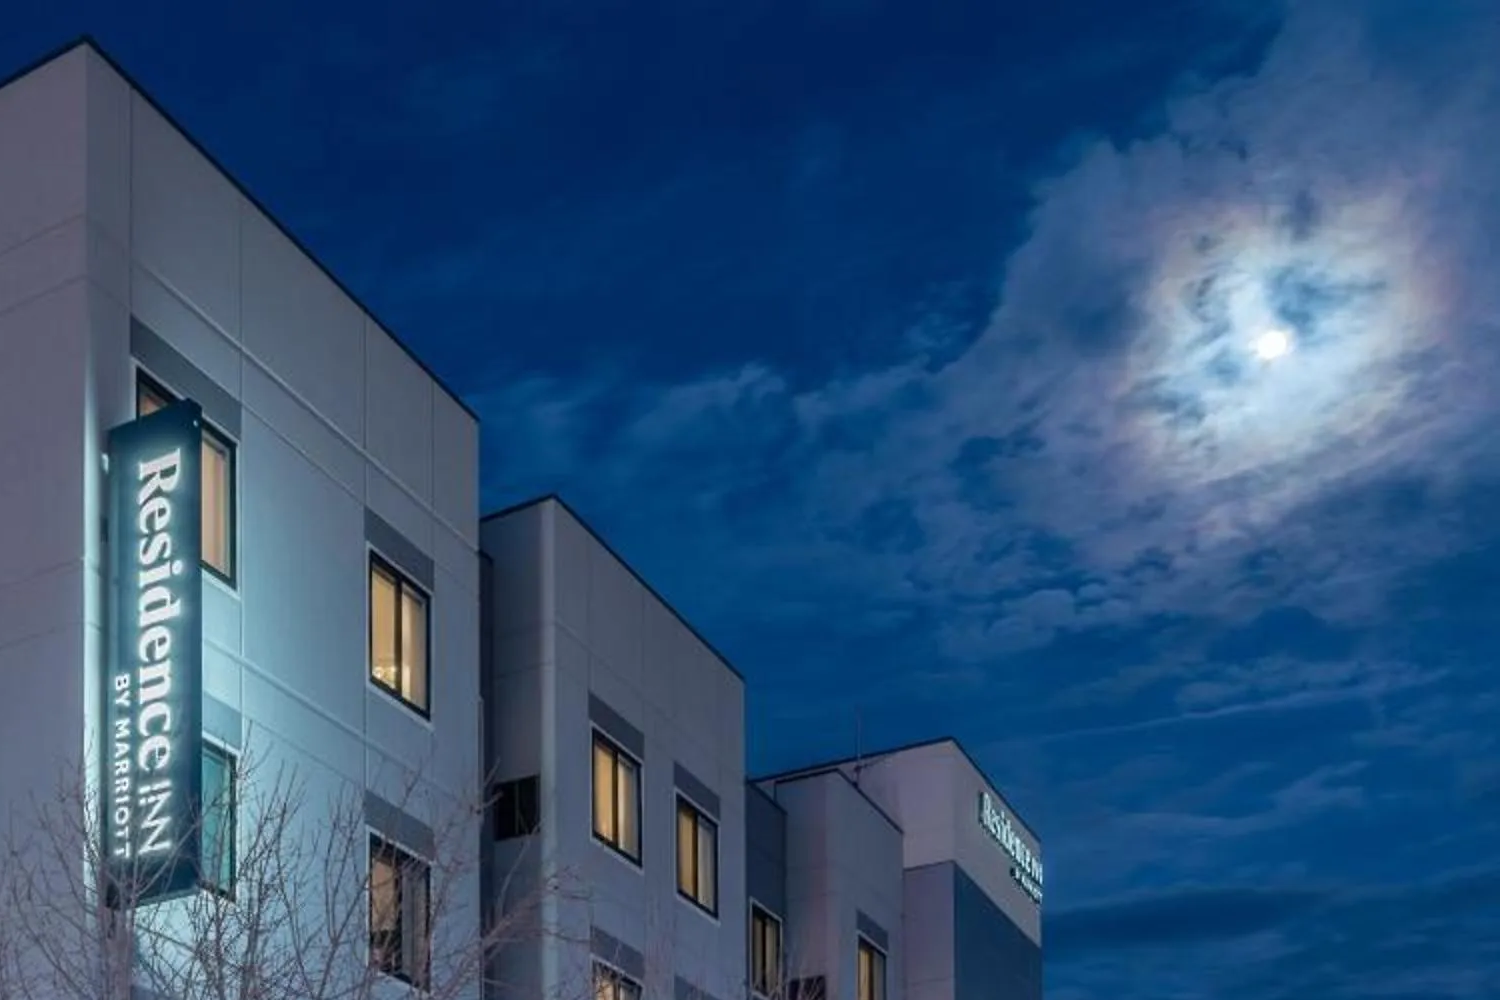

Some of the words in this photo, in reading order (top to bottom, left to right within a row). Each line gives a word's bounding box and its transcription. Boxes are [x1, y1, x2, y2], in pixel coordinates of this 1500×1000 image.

[138, 448, 182, 770] Residence
[114, 673, 130, 707] BY
[114, 718, 130, 858] MARRIOTT
